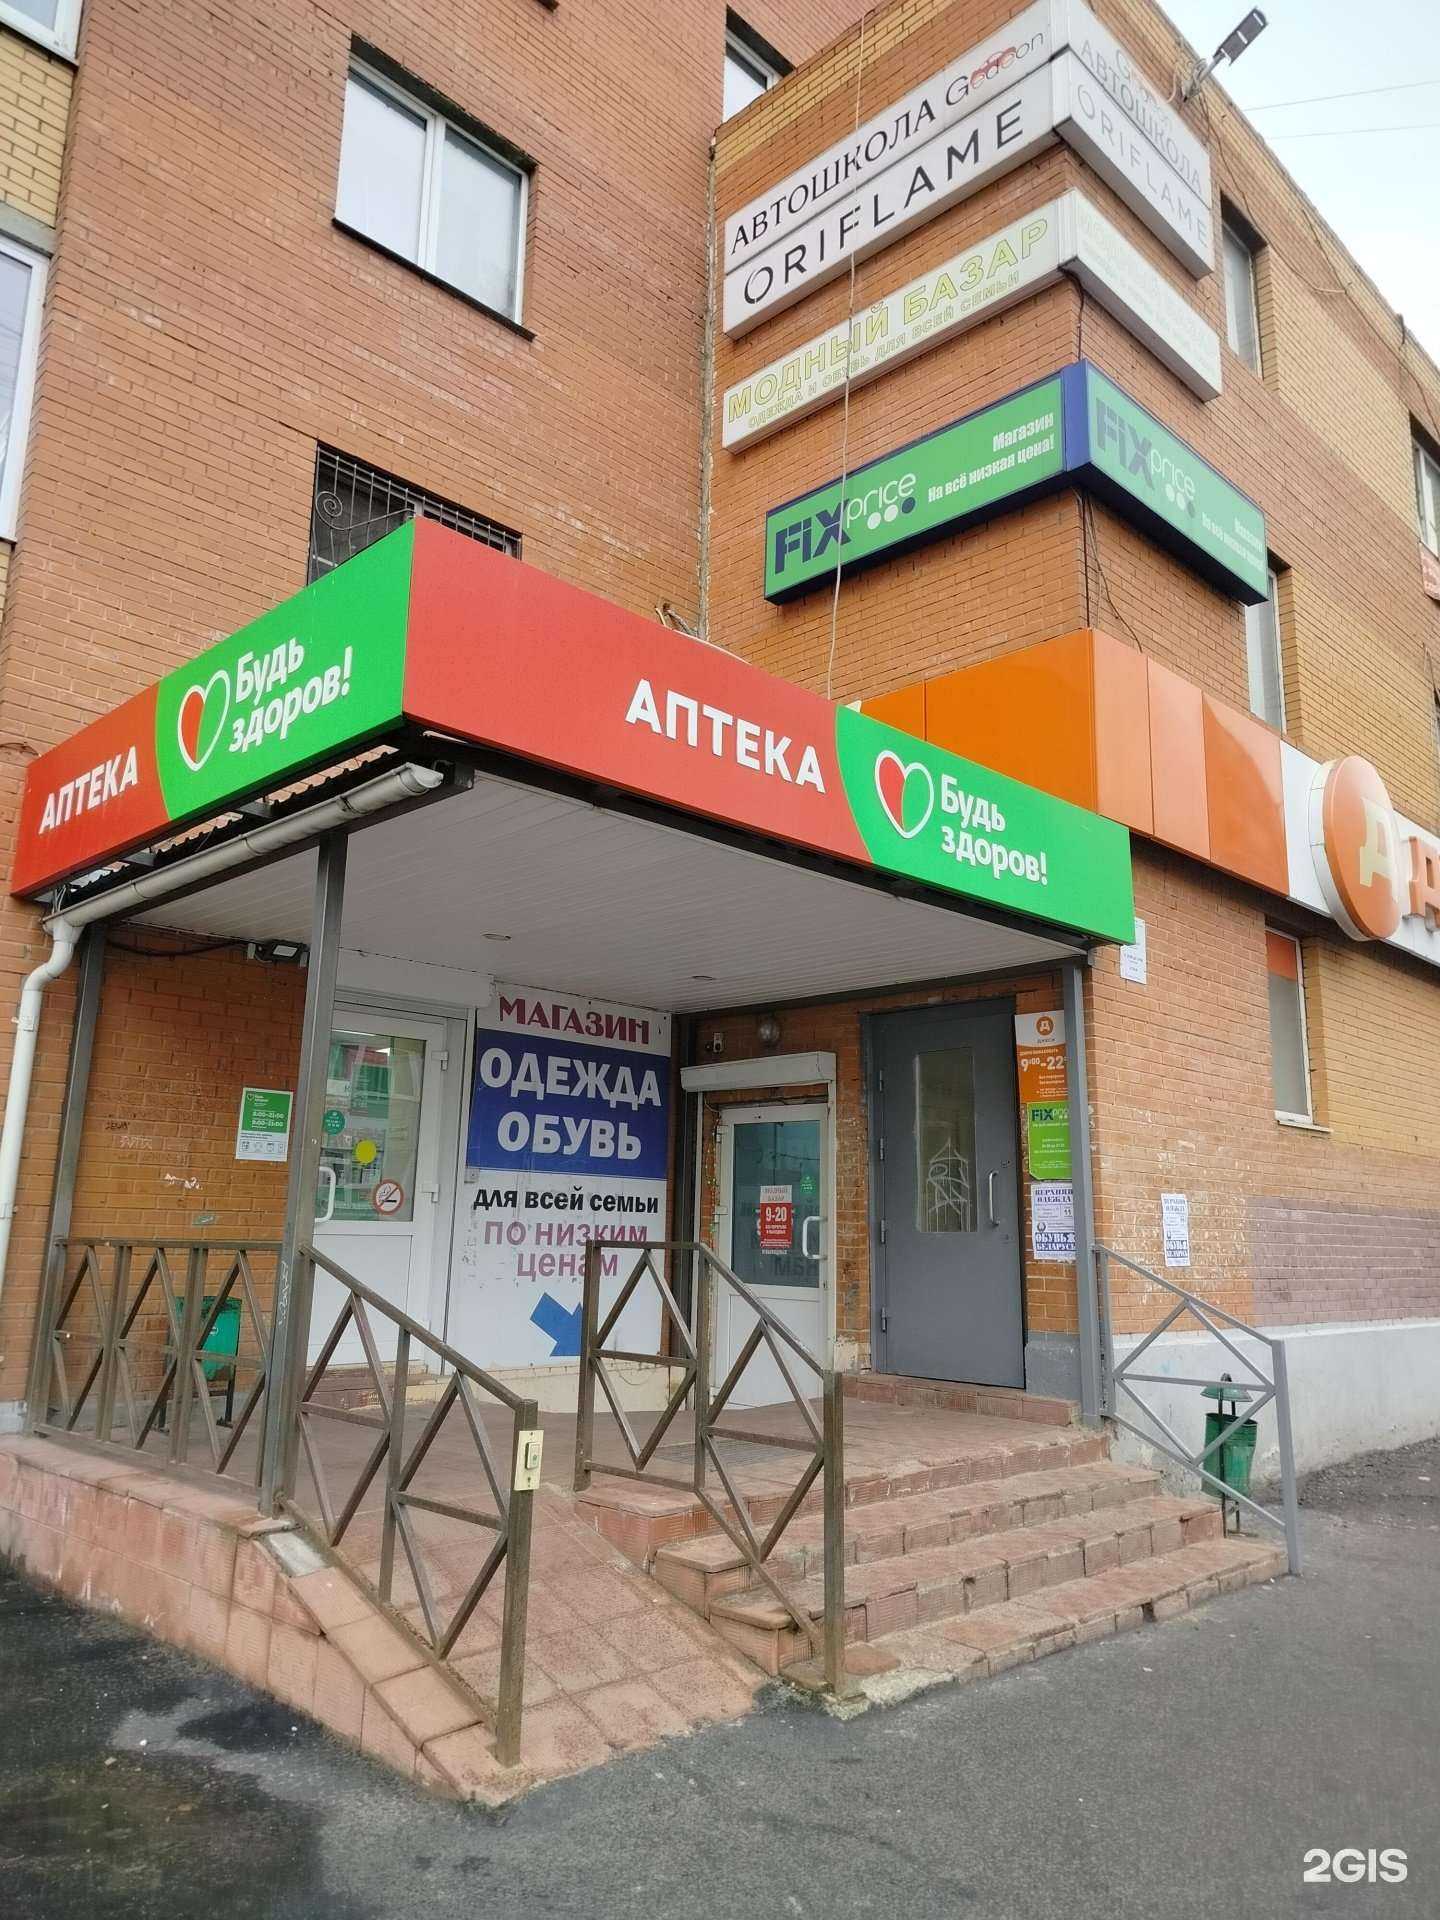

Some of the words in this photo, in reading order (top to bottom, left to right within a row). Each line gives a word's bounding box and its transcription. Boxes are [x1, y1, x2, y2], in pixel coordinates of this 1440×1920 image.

[731, 98, 936, 255] АВТОШКОЛА
[1078, 84, 1208, 248] ORIFLAME
[744, 97, 1025, 305] ORIFLAME
[728, 301, 889, 424] МОДНЫЙ
[903, 218, 1049, 325] БАЗАР
[993, 413, 1054, 452] Магазин
[928, 486, 943, 503] На
[945, 473, 967, 495] всё
[969, 453, 1015, 485] низкая
[1017, 433, 1055, 464] цена!
[228, 646, 353, 754] здоров!
[235, 636, 305, 704] Будь
[624, 678, 826, 794] АПТЕКА
[39, 746, 139, 834] АПТЕКА
[940, 773, 1007, 834] Будь
[940, 826, 1049, 887] здоров!
[499, 997, 649, 1045] МАГАЗИН
[479, 1047, 662, 1111] ОДЕЖДА
[497, 1111, 641, 1160] ОБУВЬ
[473, 1188, 518, 1211] для
[525, 1186, 584, 1212] всей
[590, 1194, 659, 1214] семьи
[484, 1221, 526, 1245] по
[765, 1206, 787, 1222] 9-20
